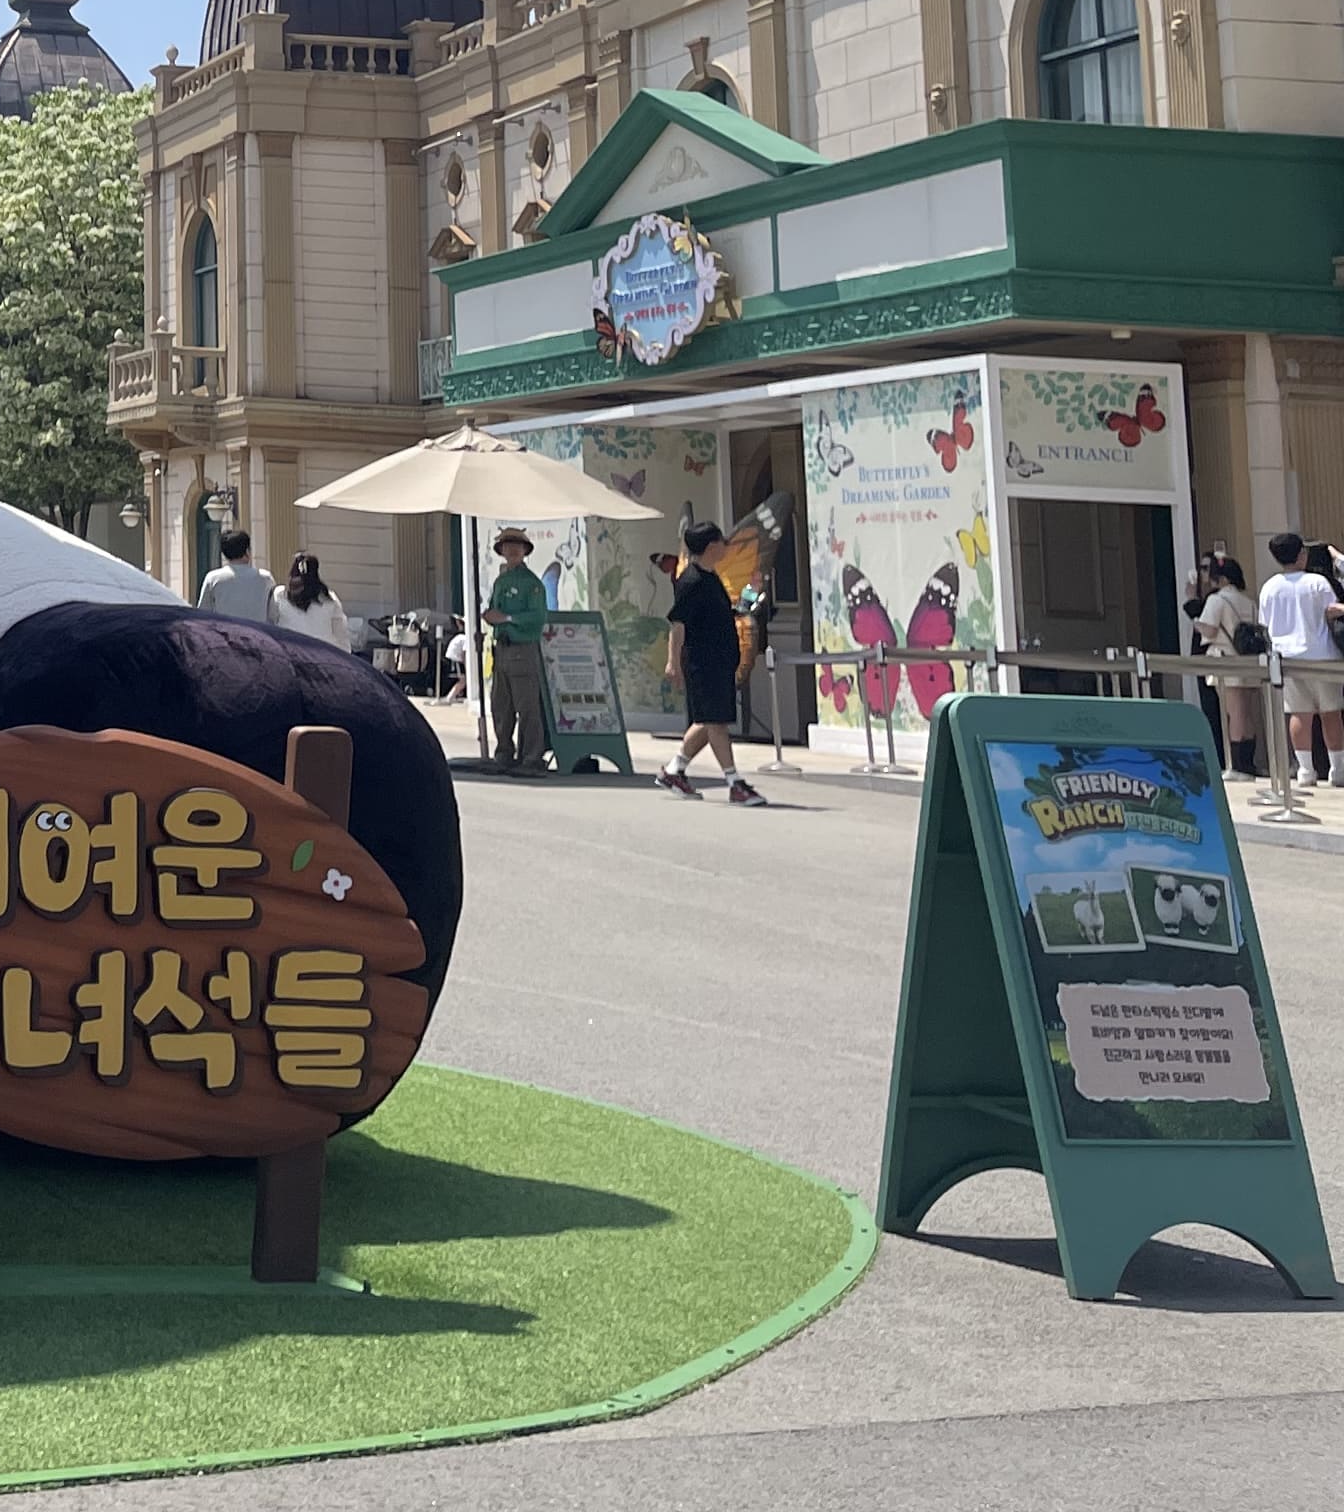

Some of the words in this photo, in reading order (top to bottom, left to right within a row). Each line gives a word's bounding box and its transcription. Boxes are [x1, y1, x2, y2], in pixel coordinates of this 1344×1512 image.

[1038, 444, 1134, 463] ENTRANCE
[842, 487, 899, 504] DREAMING
[903, 484, 950, 500] GARDEN
[1056, 773, 1155, 799] FRIENDLY
[1031, 799, 1124, 837] RANCH
[1, 948, 372, 1091] 녀석들
[1145, 1049, 1192, 1063] 사랑스러운
[1138, 1071, 1170, 1085] 만나러
[1172, 1072, 1205, 1084] 오세요!
